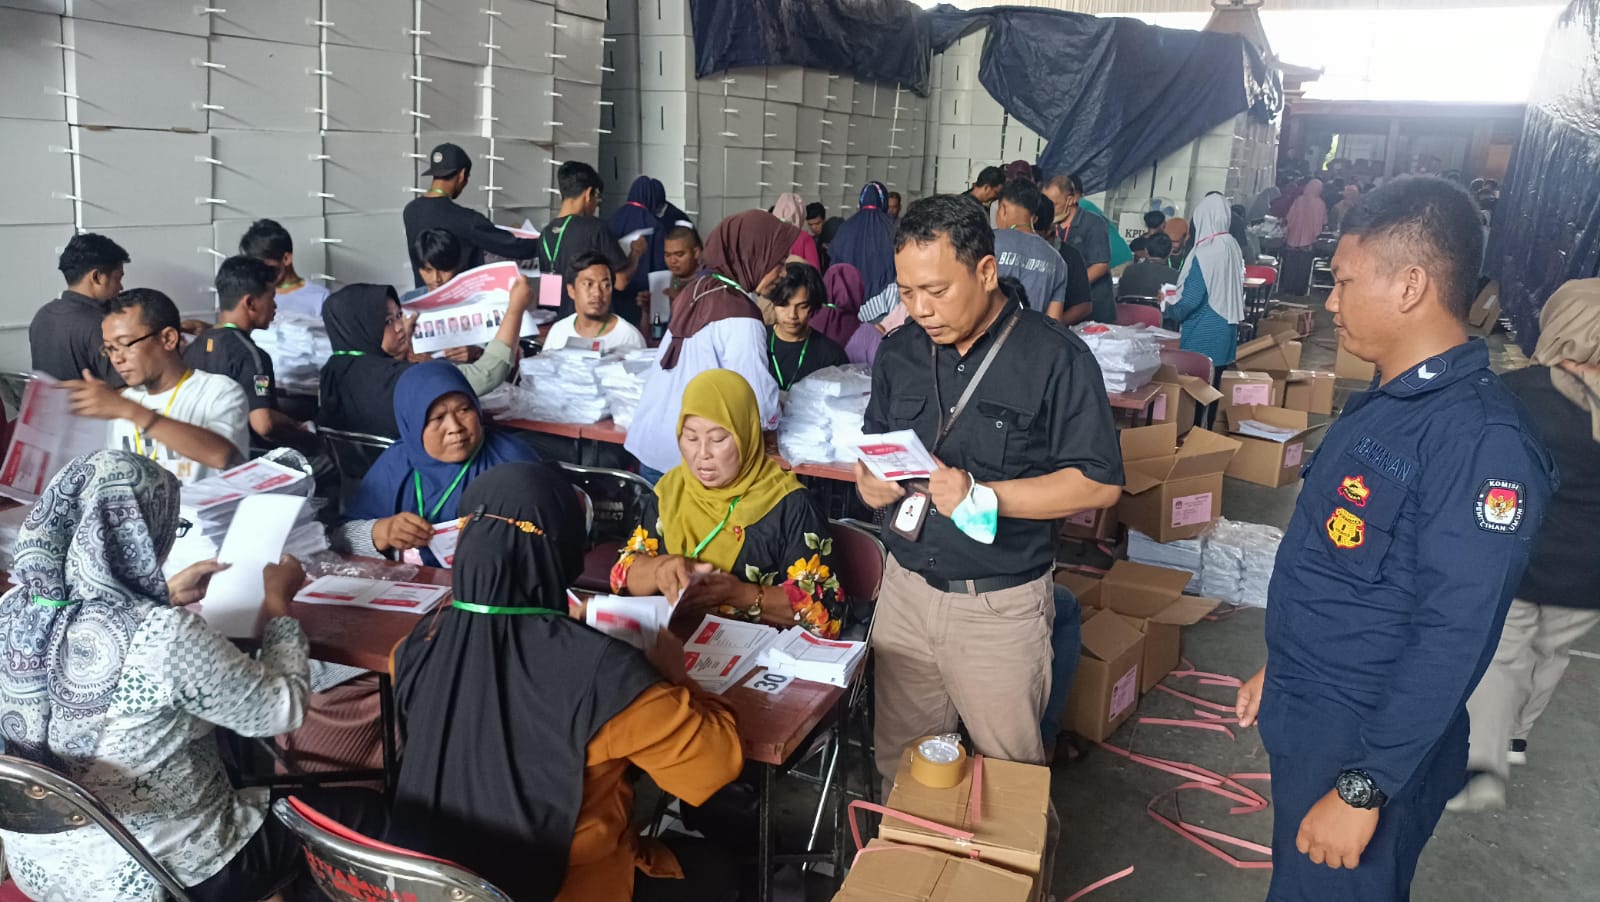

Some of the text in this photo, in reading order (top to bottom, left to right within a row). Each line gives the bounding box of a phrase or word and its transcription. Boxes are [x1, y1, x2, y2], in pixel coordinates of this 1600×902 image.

[1489, 481, 1519, 489] KOMISI
[1508, 508, 1523, 531] UMUM
[753, 673, 788, 691] 30
